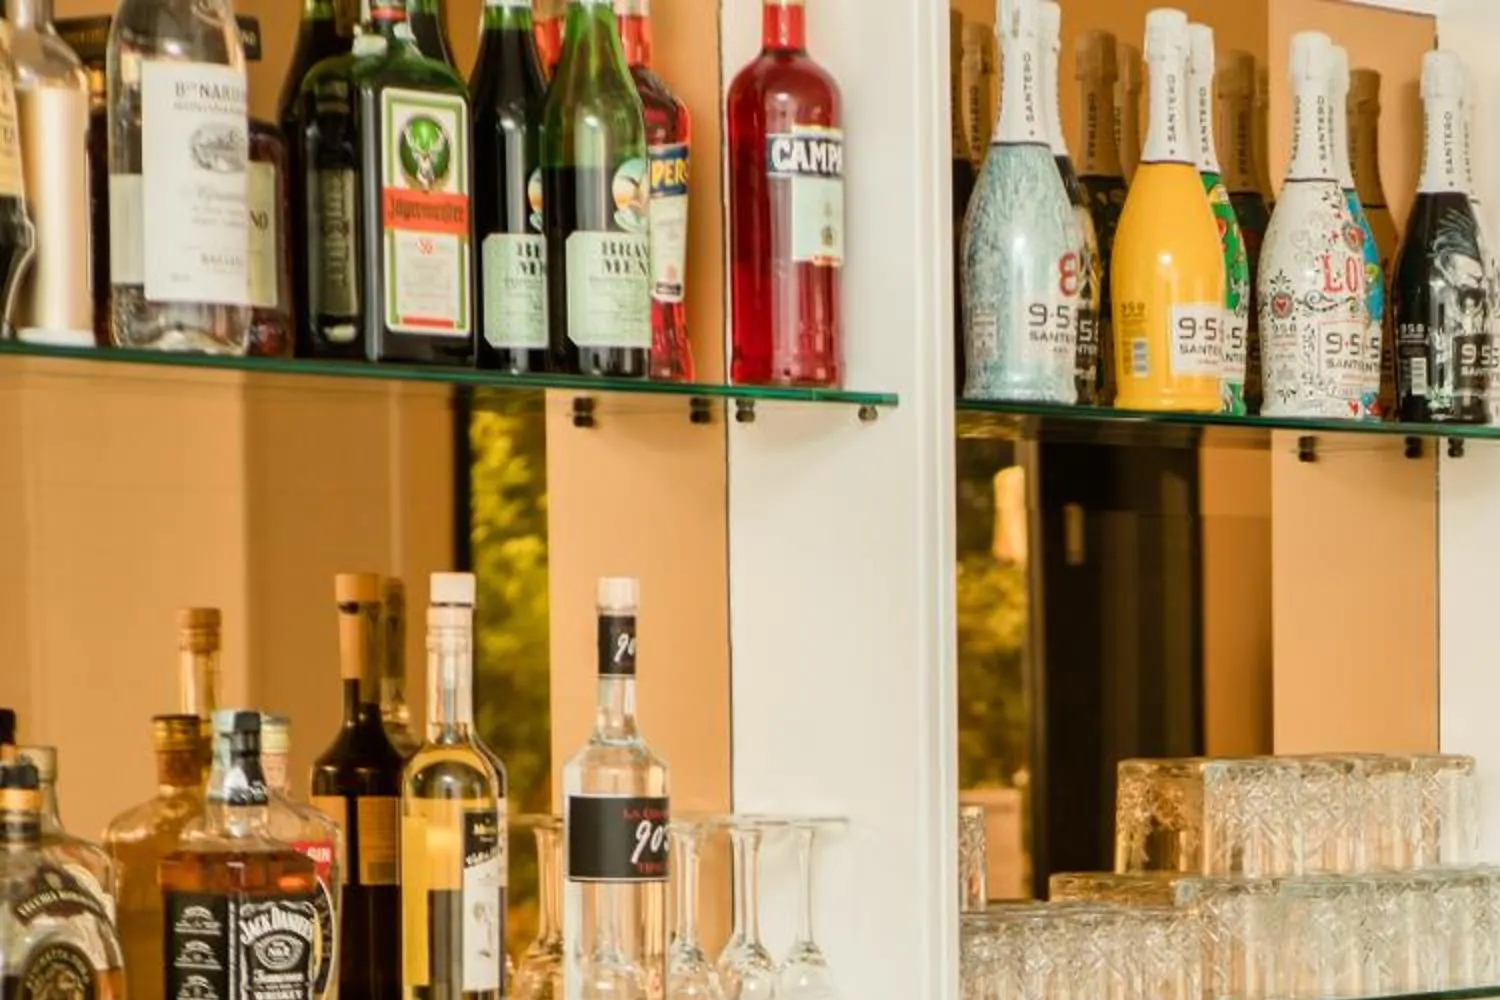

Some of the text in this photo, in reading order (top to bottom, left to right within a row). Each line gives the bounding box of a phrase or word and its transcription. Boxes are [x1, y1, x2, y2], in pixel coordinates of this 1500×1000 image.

[1022, 51, 1036, 122] SANTERO
[1167, 74, 1177, 143] SANTERO
[1316, 95, 1327, 161] SANTERO
[1443, 111, 1454, 175] SANTERO
